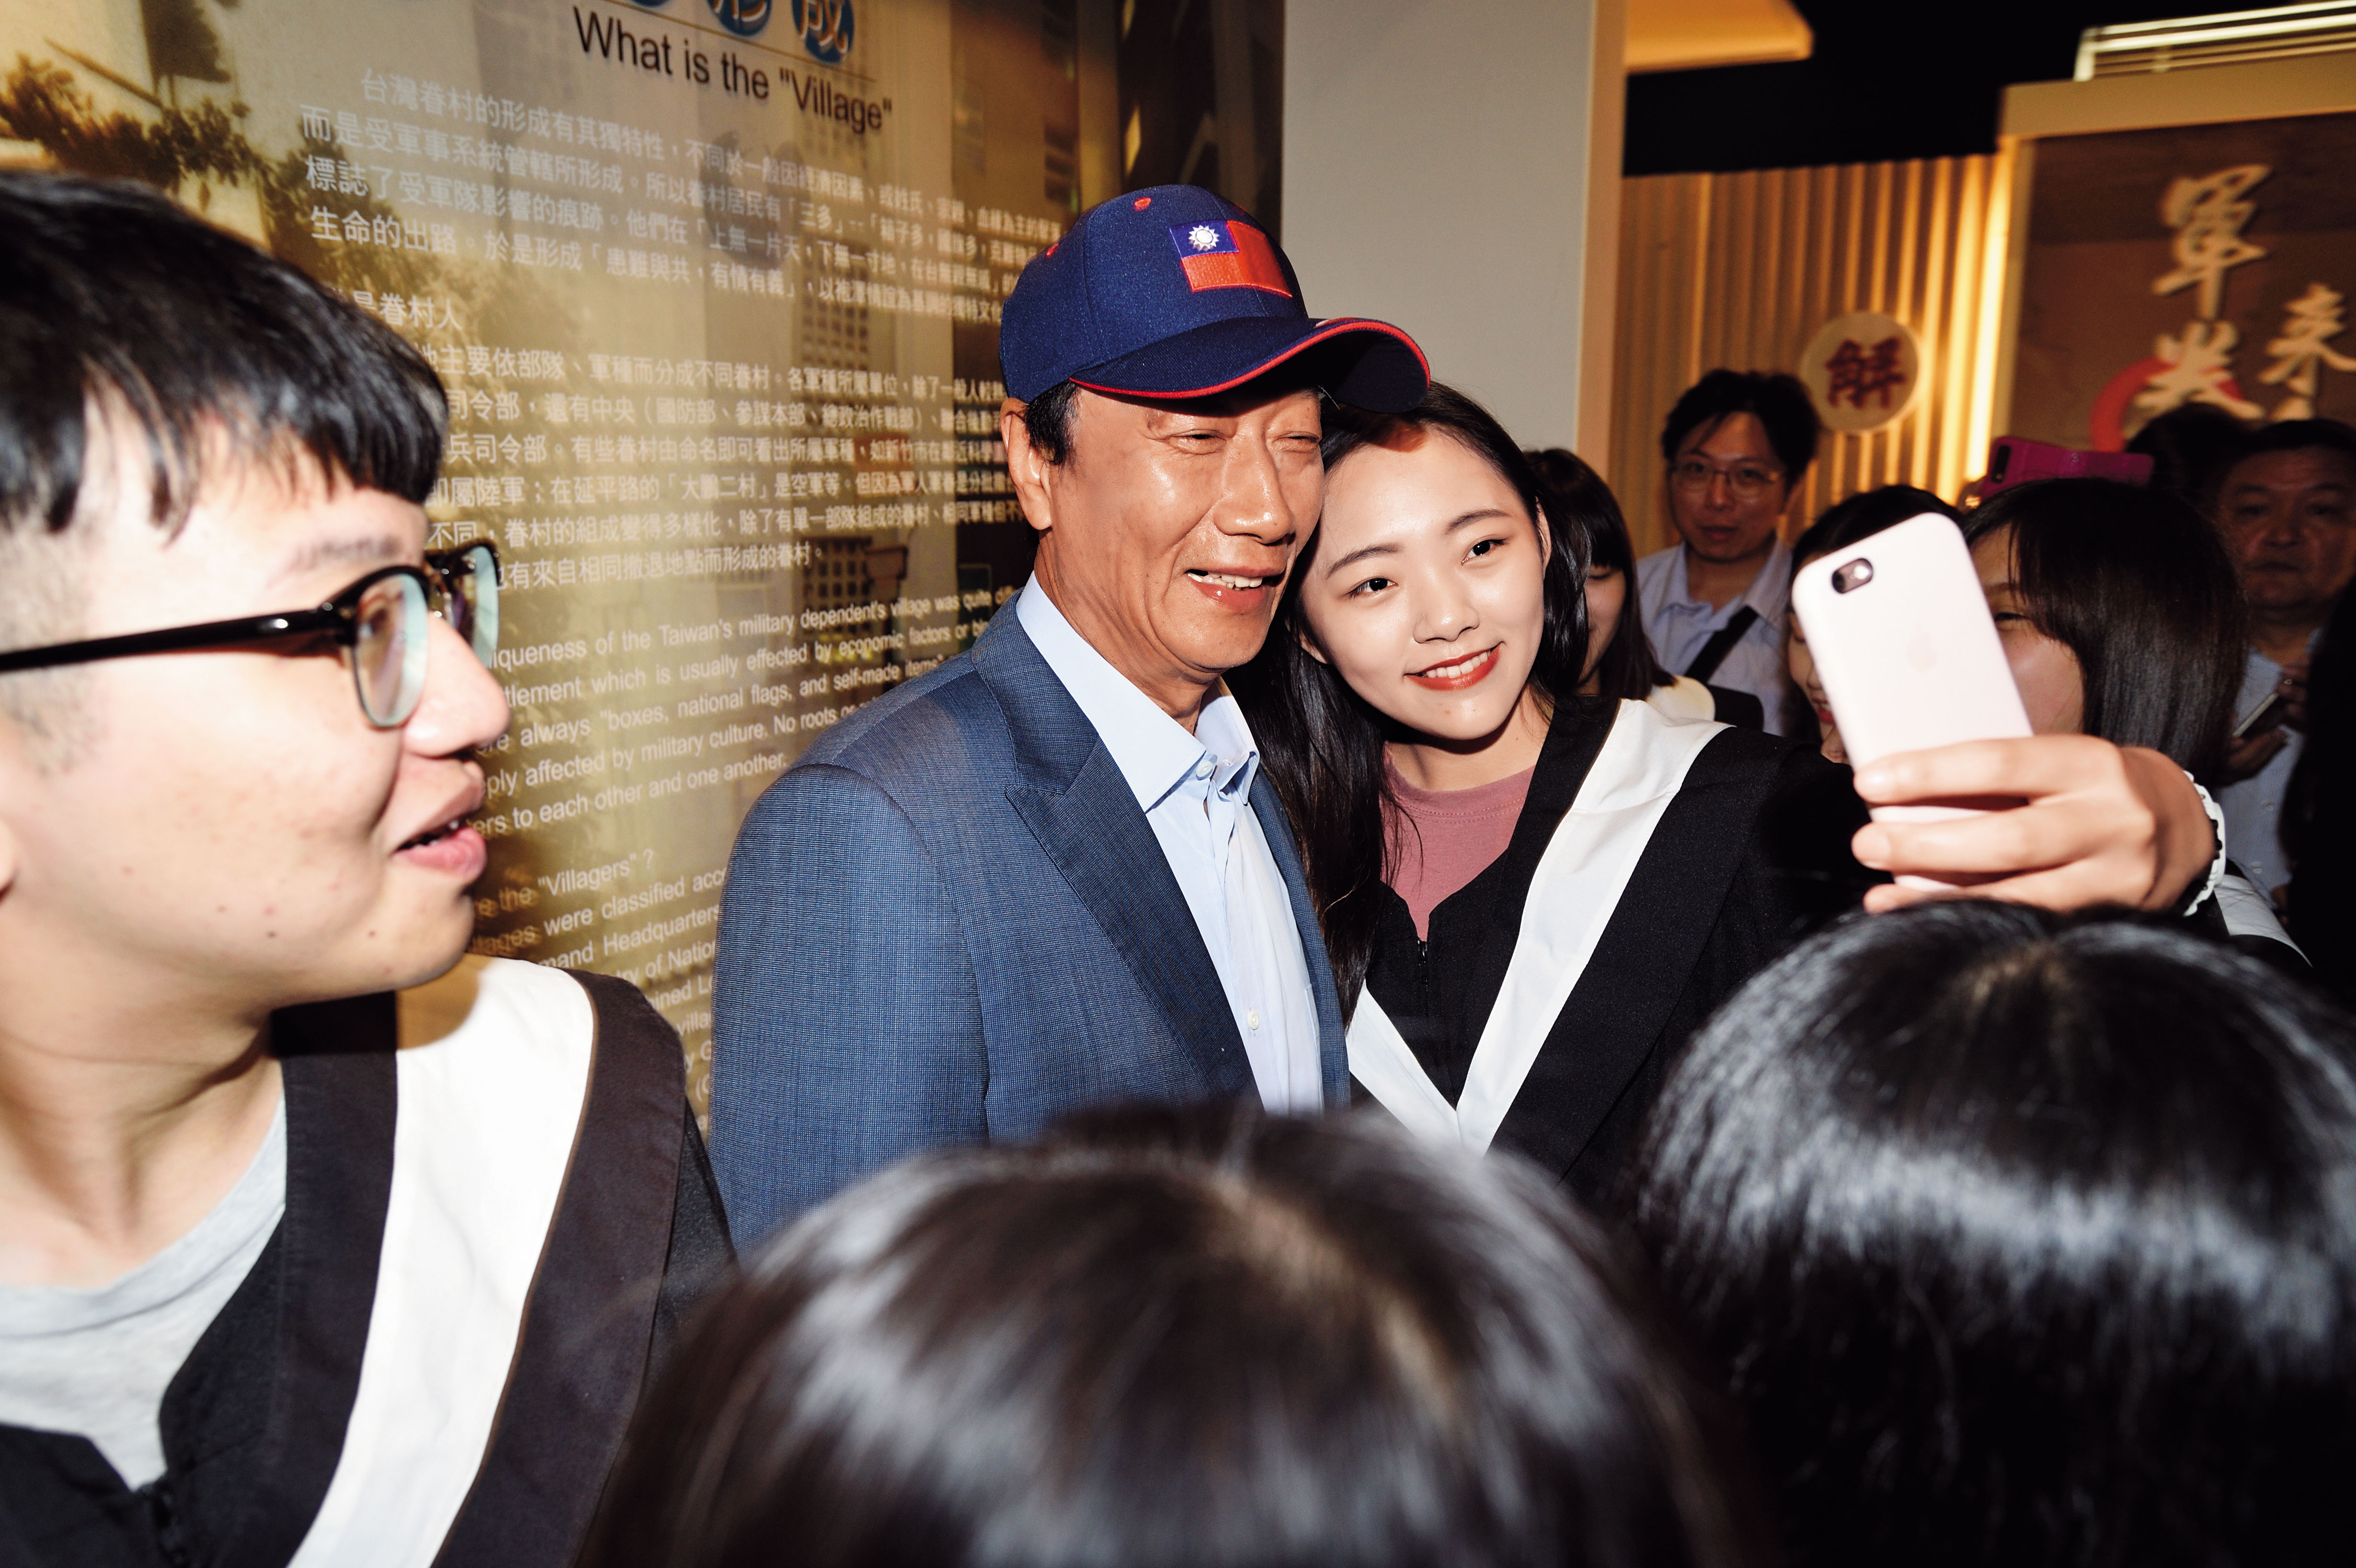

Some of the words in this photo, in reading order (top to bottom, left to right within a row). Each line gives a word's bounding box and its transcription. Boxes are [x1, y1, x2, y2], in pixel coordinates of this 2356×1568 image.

[574, 6, 673, 76] What
[683, 38, 710, 85] is
[721, 52, 770, 101] the
[779, 66, 892, 135] "Village"
[334, 288, 462, 331] 是眷村人
[490, 639, 587, 673] iqueness
[595, 630, 615, 656] of
[622, 627, 652, 653] the
[659, 618, 732, 648] Taiwan's
[738, 612, 795, 636] military
[800, 600, 887, 630] dependent's
[890, 595, 931, 620] village
[934, 595, 960, 612] was
[962, 588, 993, 612] quite
[503, 676, 582, 708] tlement
[592, 669, 646, 695] which
[656, 665, 671, 686] is
[679, 653, 739, 683] usually
[746, 643, 808, 670] effected
[814, 640, 832, 664] by
[838, 631, 905, 658] economic
[909, 624, 951, 646] factors
[955, 623, 970, 640] or
[520, 717, 591, 747] always
[600, 704, 669, 732] "boxes,
[677, 686, 744, 718] national
[751, 683, 793, 707] flags,
[799, 674, 828, 697] and
[833, 664, 900, 691] self-made
[525, 749, 605, 787] affected
[612, 743, 635, 772] by
[641, 734, 704, 762] military
[709, 720, 769, 748] culture.
[774, 713, 796, 735] No
[800, 706, 838, 729] roots
[467, 814, 507, 834] ers
[513, 806, 534, 829] to
[540, 793, 589, 822] each
[595, 783, 643, 810] other
[649, 772, 681, 797] and
[687, 764, 718, 788] one
[723, 751, 787, 781] another.
[498, 887, 532, 912] the
[538, 853, 636, 897] "Villagers"
[644, 848, 654, 870] ?
[544, 907, 593, 936] were
[601, 876, 685, 920] classified
[646, 955, 664, 979] of
[676, 1011, 712, 1036] villa
